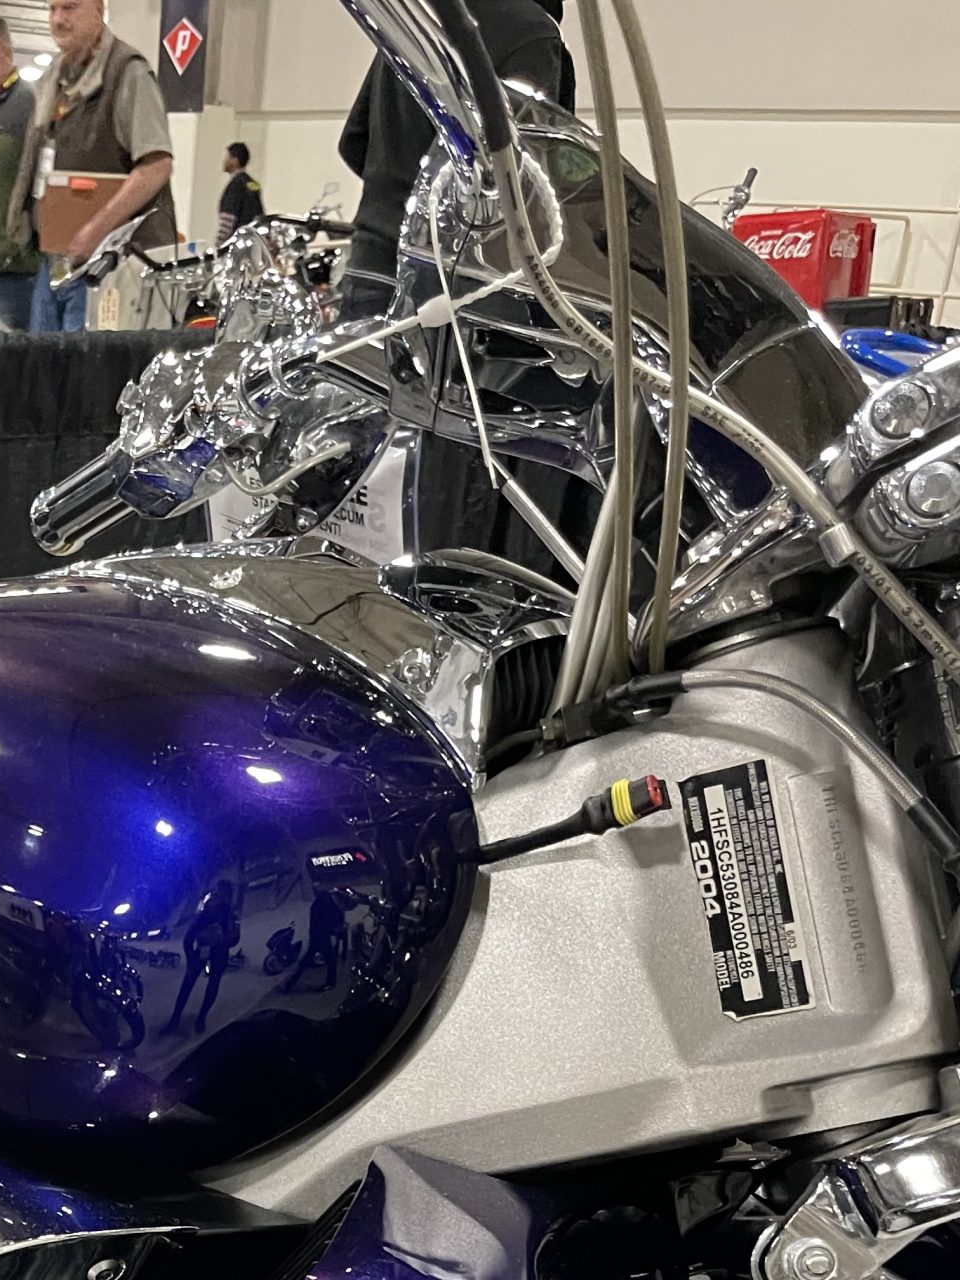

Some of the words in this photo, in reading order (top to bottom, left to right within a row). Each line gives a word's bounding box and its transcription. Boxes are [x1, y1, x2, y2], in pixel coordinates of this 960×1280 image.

[690, 839, 723, 919] 2004
[707, 807, 756, 979] 1HFSC53084A000486
[785, 929, 798, 949] 6/03
[712, 950, 732, 992] MODEL
